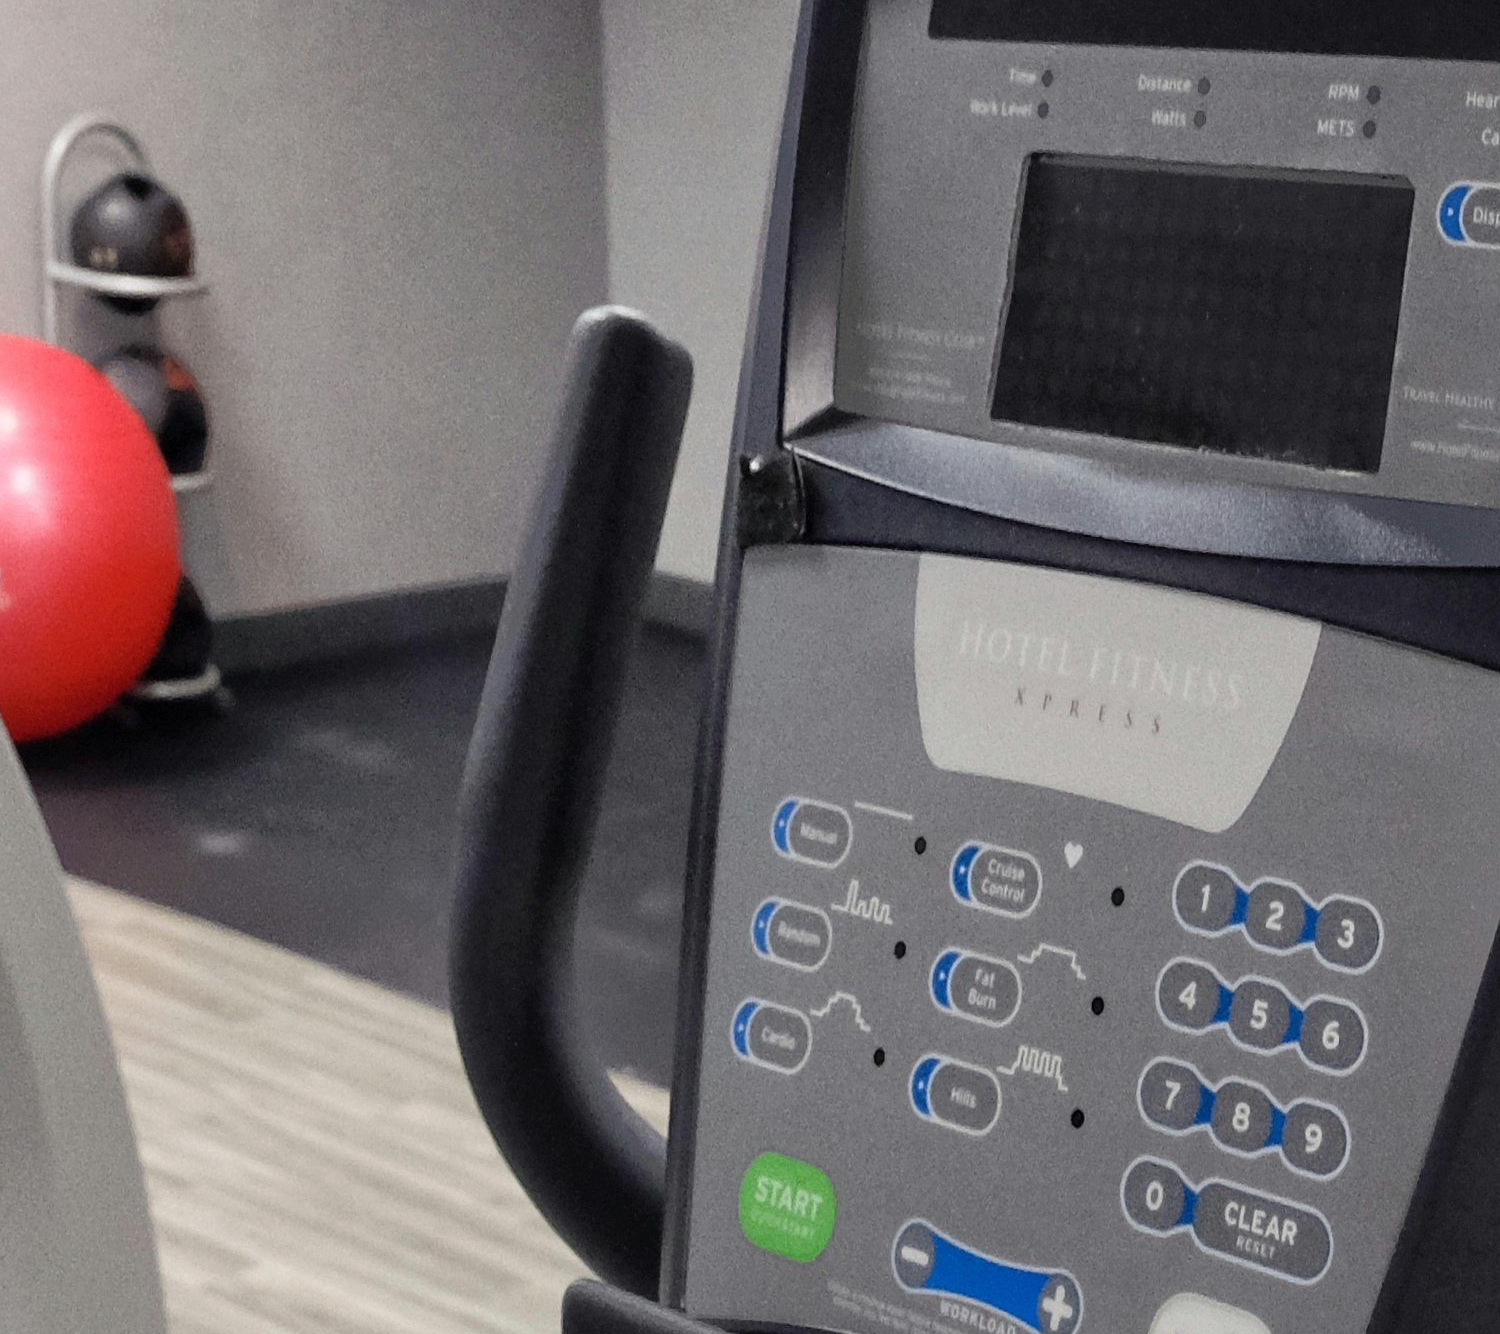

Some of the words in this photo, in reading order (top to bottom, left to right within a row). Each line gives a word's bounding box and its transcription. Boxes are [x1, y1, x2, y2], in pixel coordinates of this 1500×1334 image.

[1137, 73, 1192, 93] Distance
[1328, 83, 1360, 102] RPM
[1001, 101, 1033, 117] Level
[1151, 108, 1186, 127] Watts
[1316, 120, 1354, 137] METS
[959, 619, 1072, 676] HOTEL
[1089, 646, 1244, 709] FITNESS
[1014, 687, 1160, 734] XPRESS
[988, 858, 1025, 883] Cruise
[981, 878, 1025, 903] Control
[1200, 884, 1211, 913] 1
[1265, 900, 1284, 931] 2
[1337, 919, 1355, 949] 3
[974, 968, 995, 988] Fat
[968, 987, 997, 1010] Burn
[1178, 981, 1197, 1010] 4
[1250, 999, 1269, 1030] 5
[1322, 1020, 1340, 1050] 6
[950, 1086, 977, 1109] Hills
[1165, 1079, 1181, 1111] 7
[1232, 1102, 1250, 1132] 8
[1305, 1123, 1323, 1154] 9
[754, 1175, 824, 1222] START
[1145, 1180, 1164, 1211] 0
[1224, 1200, 1298, 1247] CLEAR
[1236, 1235, 1276, 1259] RESET
